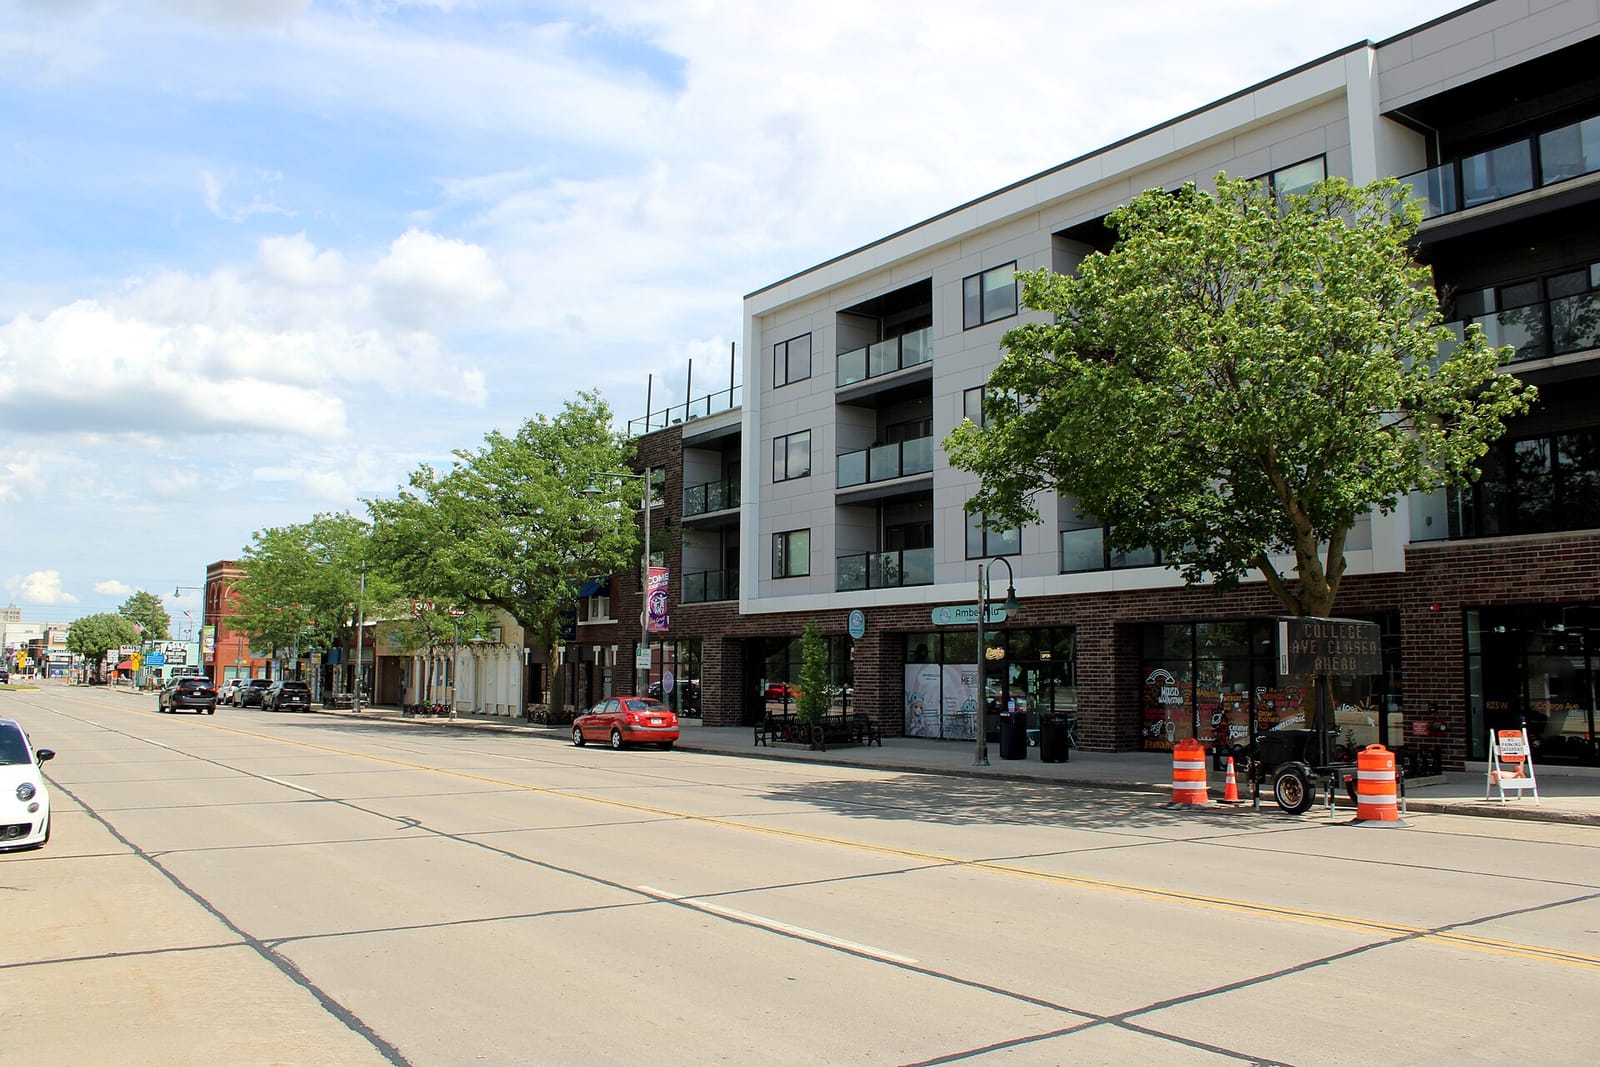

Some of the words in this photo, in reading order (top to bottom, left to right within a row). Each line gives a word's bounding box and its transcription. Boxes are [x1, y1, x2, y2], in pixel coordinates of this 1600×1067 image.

[648, 573, 669, 584] COME
[1304, 623, 1362, 639] COLLEGE
[1292, 640, 1317, 654] AVE
[1328, 640, 1377, 655] CLOSED
[1314, 656, 1357, 671] AHEAD
